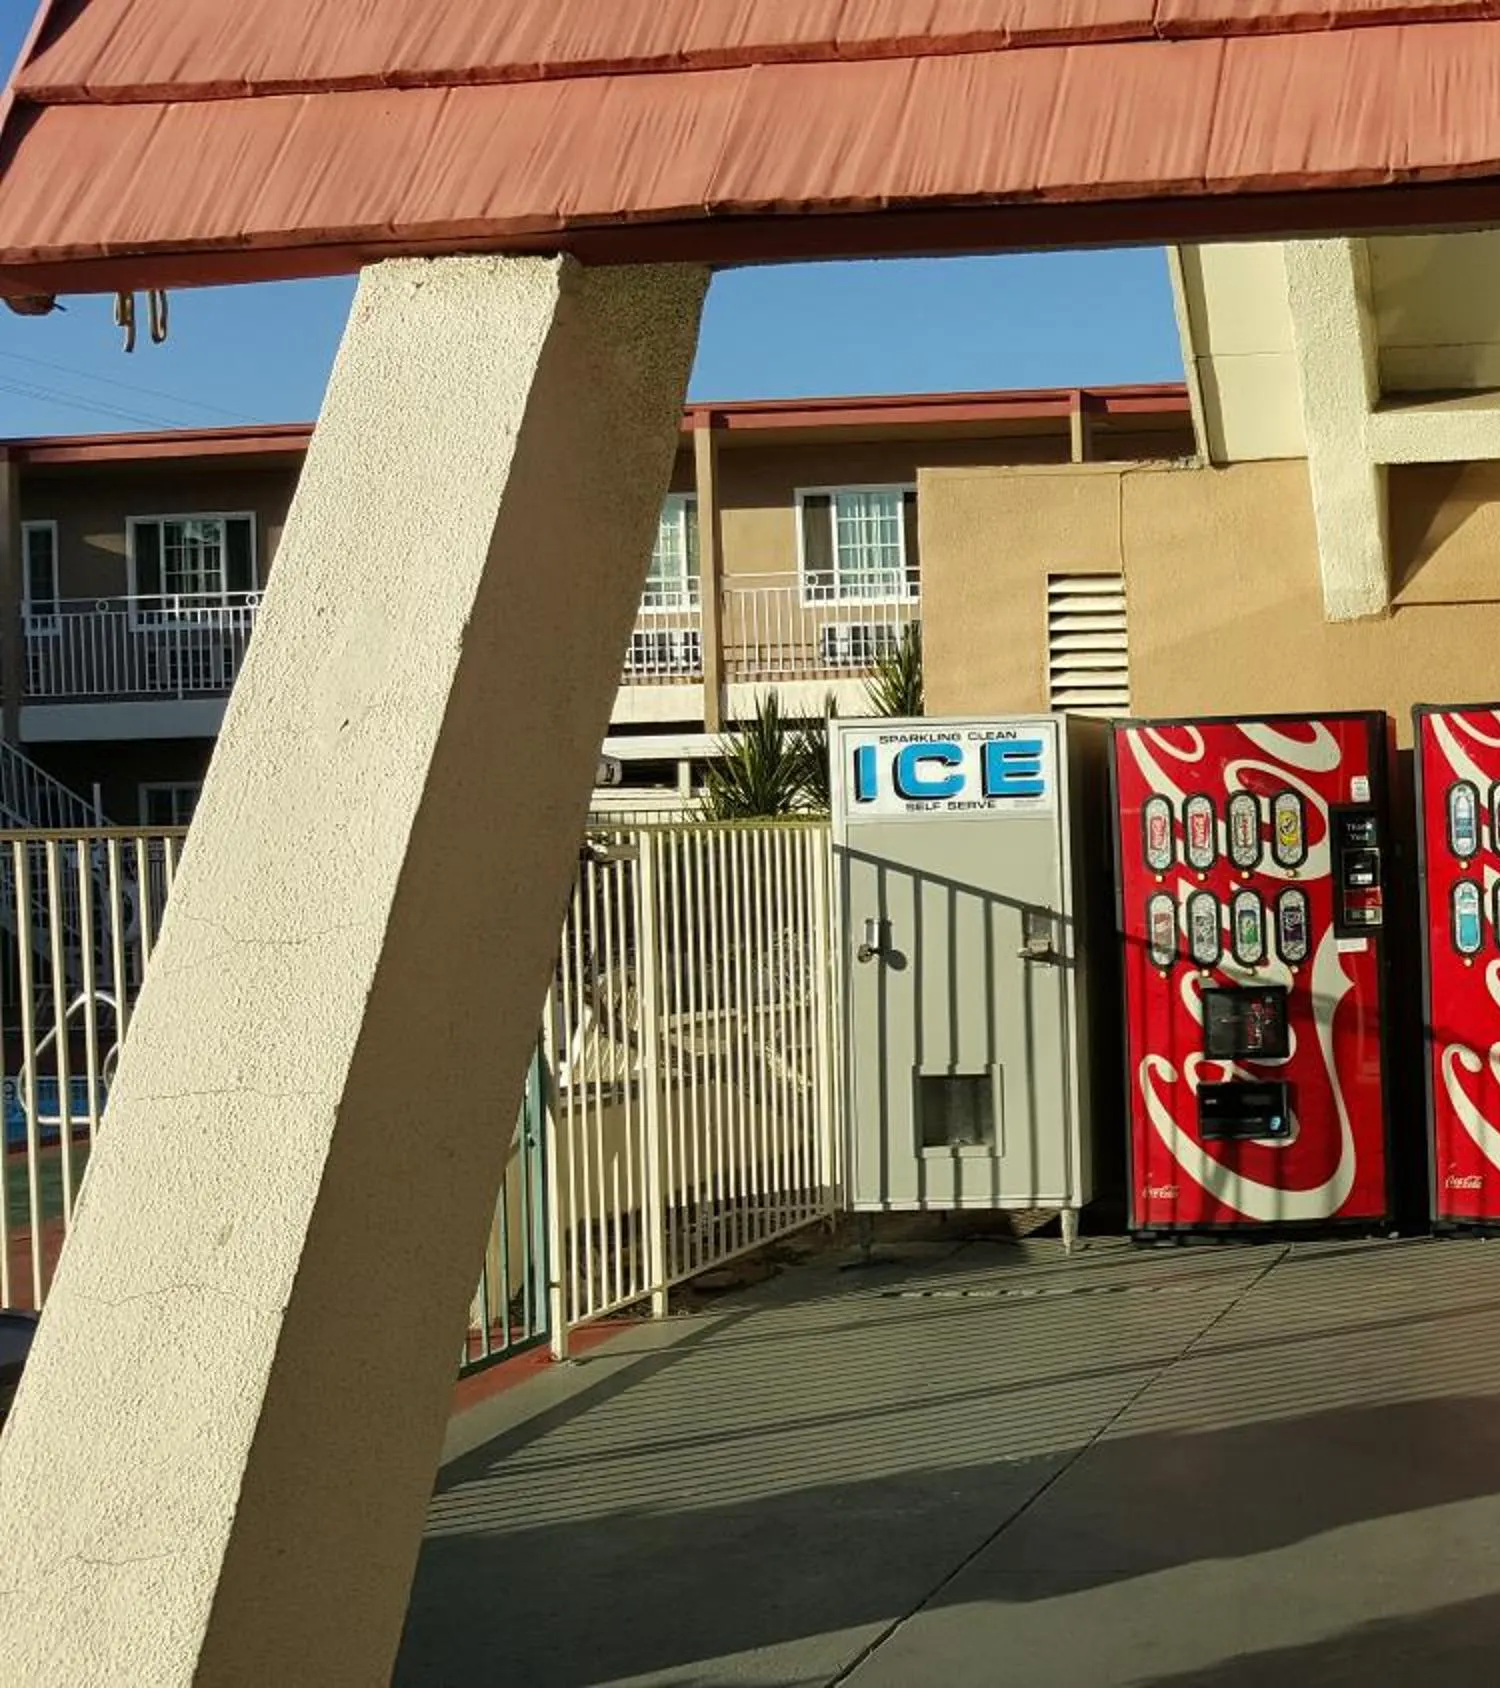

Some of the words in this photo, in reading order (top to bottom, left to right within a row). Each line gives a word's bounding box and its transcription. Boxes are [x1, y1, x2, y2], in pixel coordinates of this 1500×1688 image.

[879, 732, 960, 745] SPARKLING
[967, 731, 1017, 741] CLEAN
[853, 739, 1045, 803] ICE
[905, 801, 942, 811] SELF
[947, 800, 997, 811] SERVE
